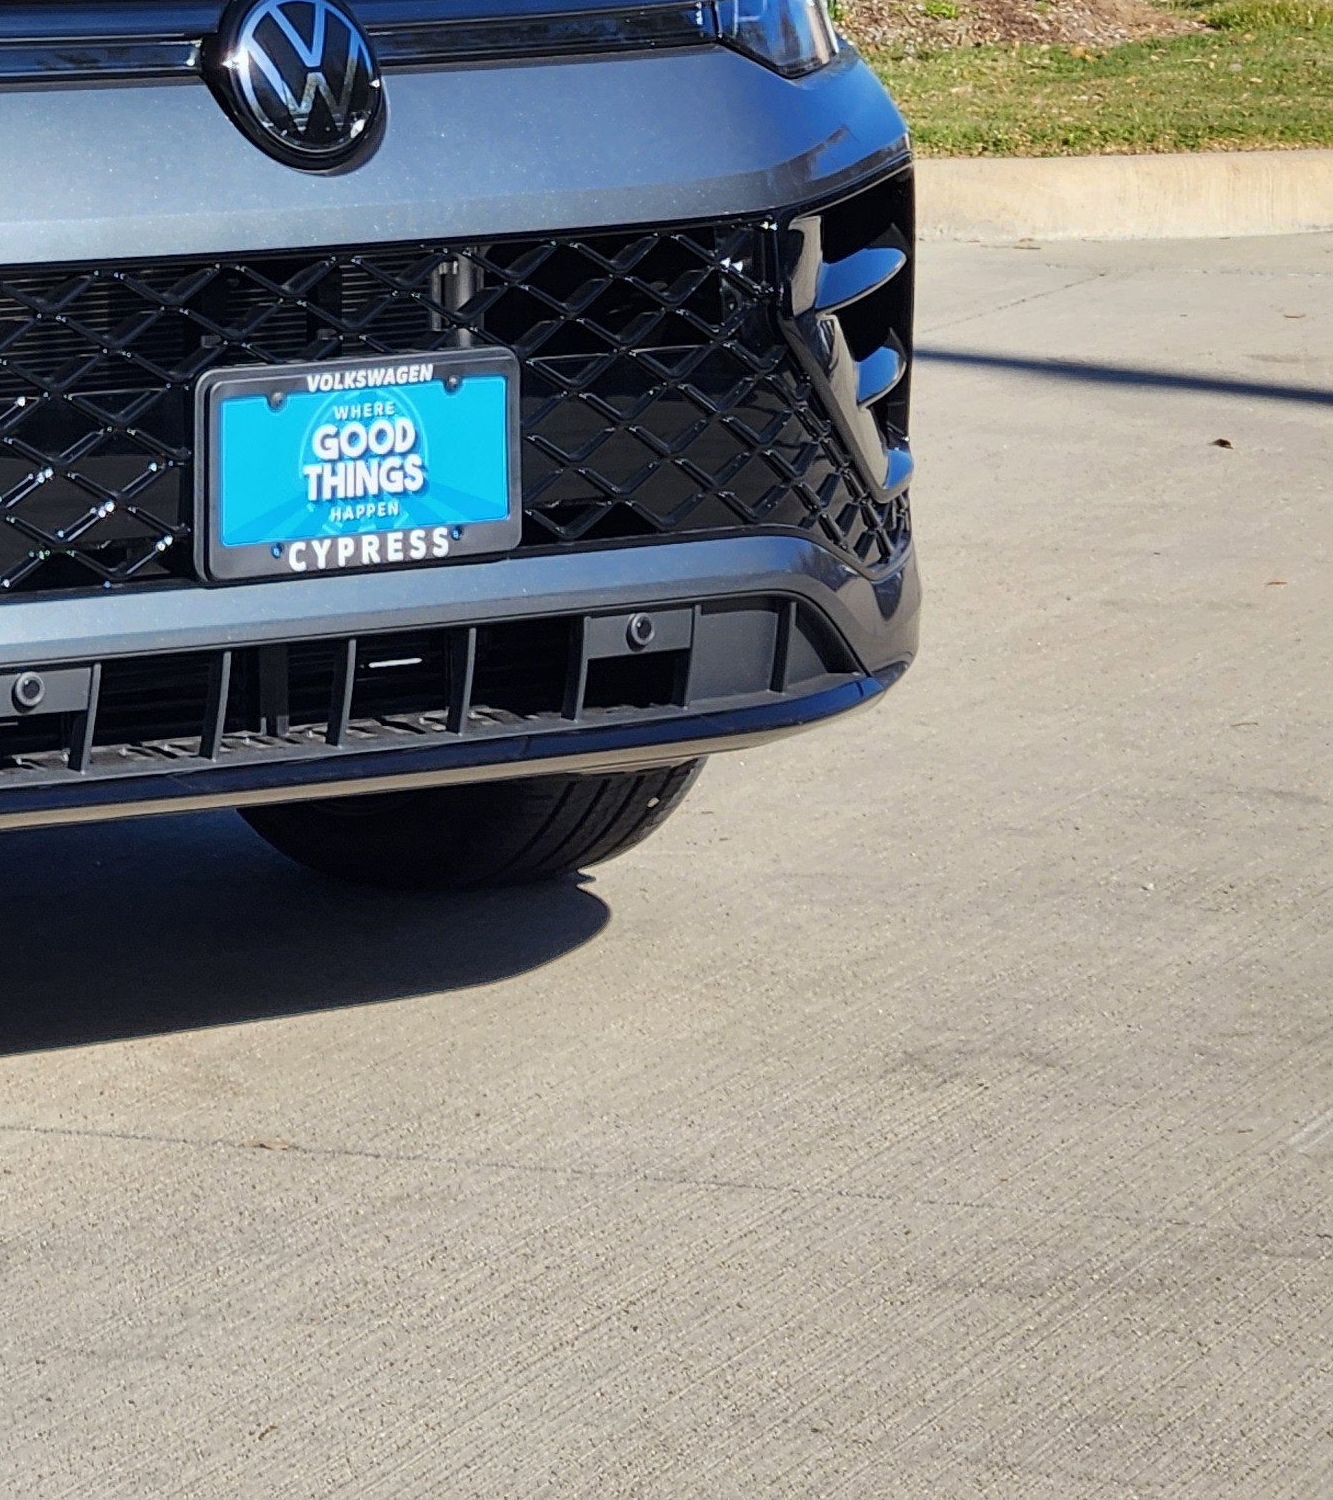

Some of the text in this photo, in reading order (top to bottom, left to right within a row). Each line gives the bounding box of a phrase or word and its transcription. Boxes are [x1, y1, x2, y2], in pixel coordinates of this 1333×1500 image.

[307, 364, 434, 392] VOLKSWAGEN
[334, 401, 396, 421] WHERE
[312, 418, 416, 460] GOOD
[303, 454, 426, 501] THINGS
[329, 501, 400, 522] HAPPEN
[288, 526, 450, 572] CYPRESS
